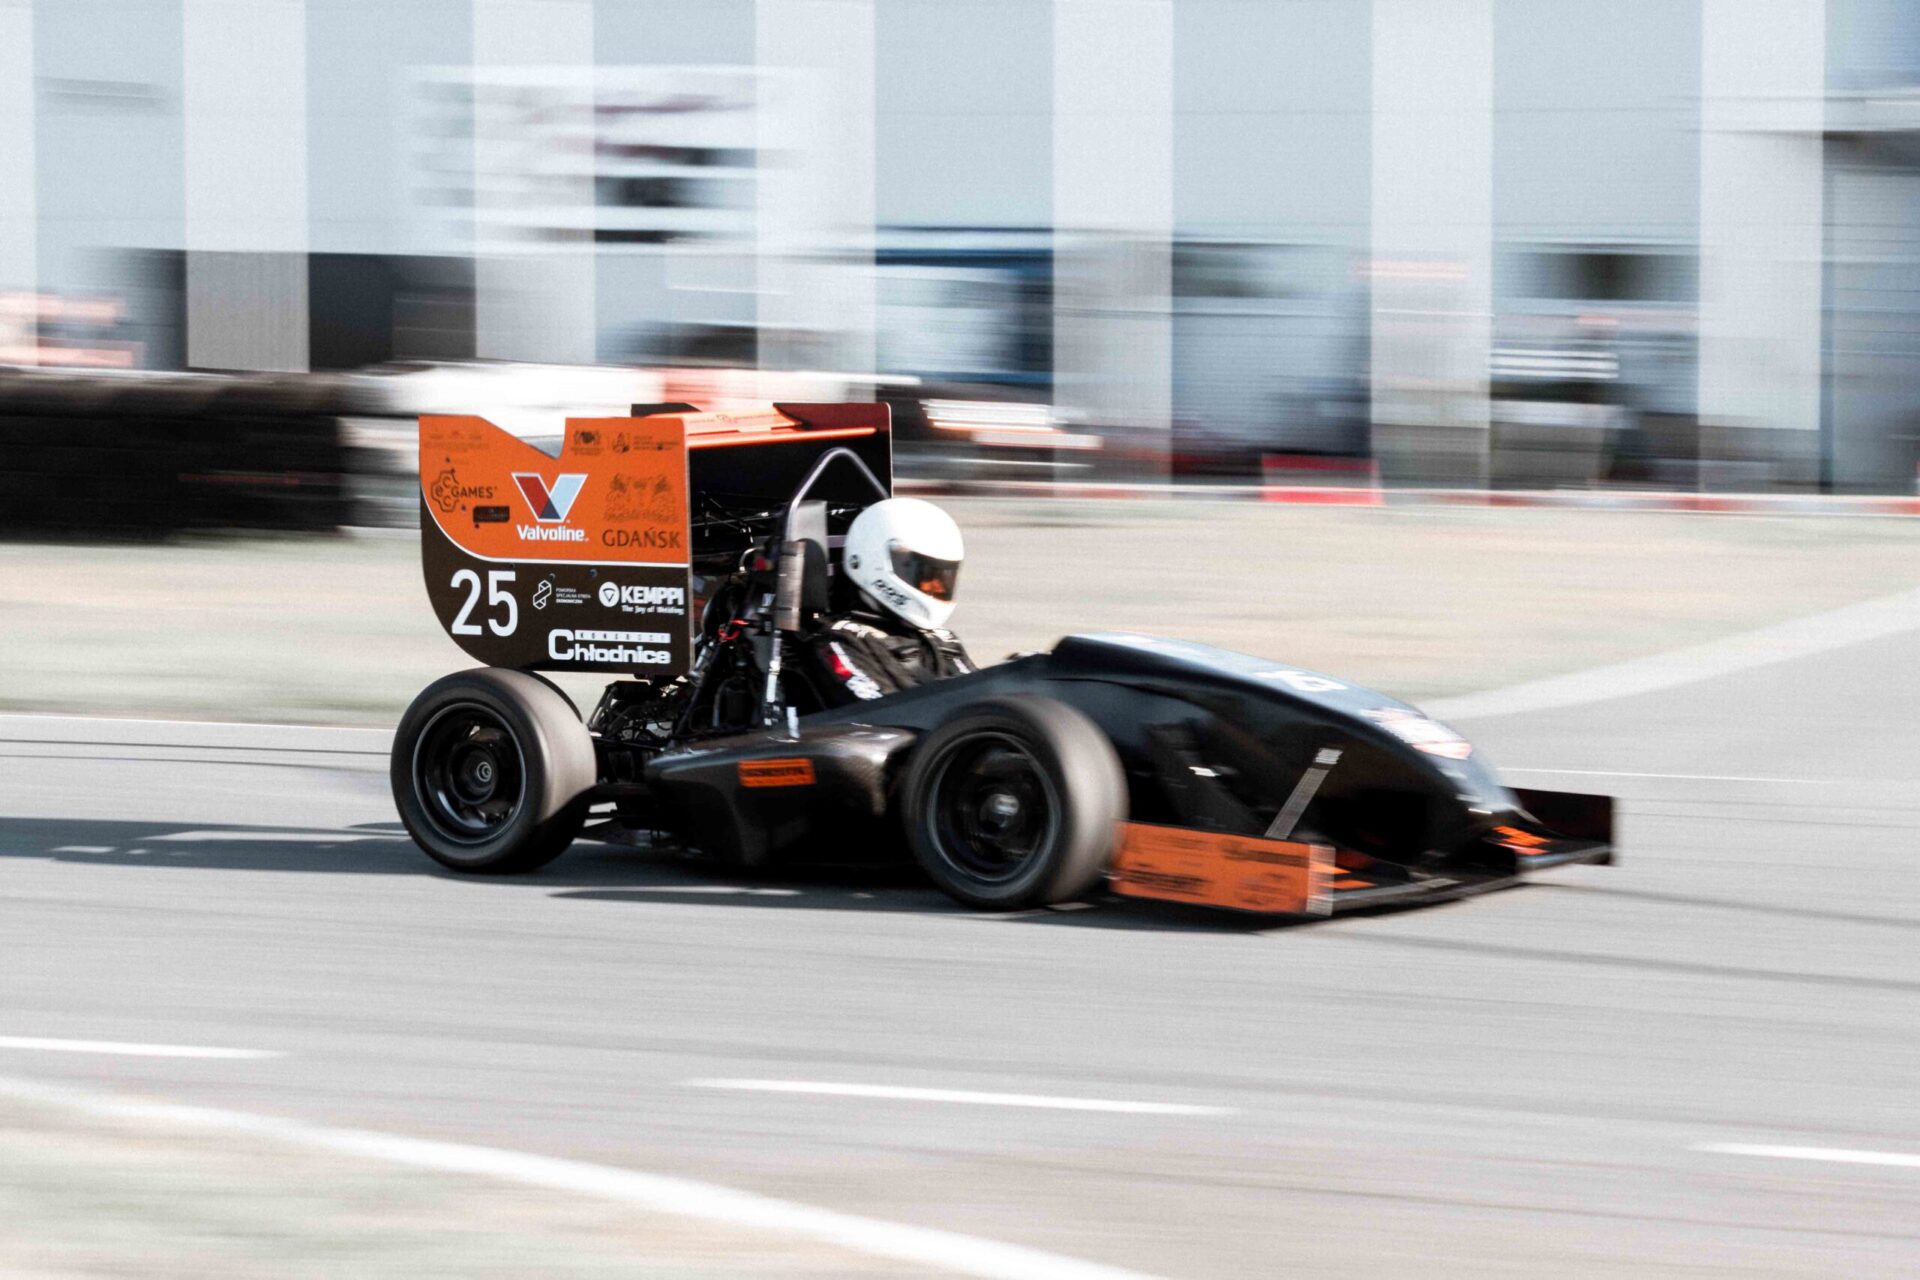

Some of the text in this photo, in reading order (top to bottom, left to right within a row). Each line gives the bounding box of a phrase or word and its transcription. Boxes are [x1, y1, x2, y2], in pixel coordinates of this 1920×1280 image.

[451, 486, 494, 499] GAMES
[516, 524, 586, 542] Valvoline
[601, 527, 682, 549] GDAŃSK
[450, 568, 519, 637] 25
[621, 585, 685, 606] KEMPPI
